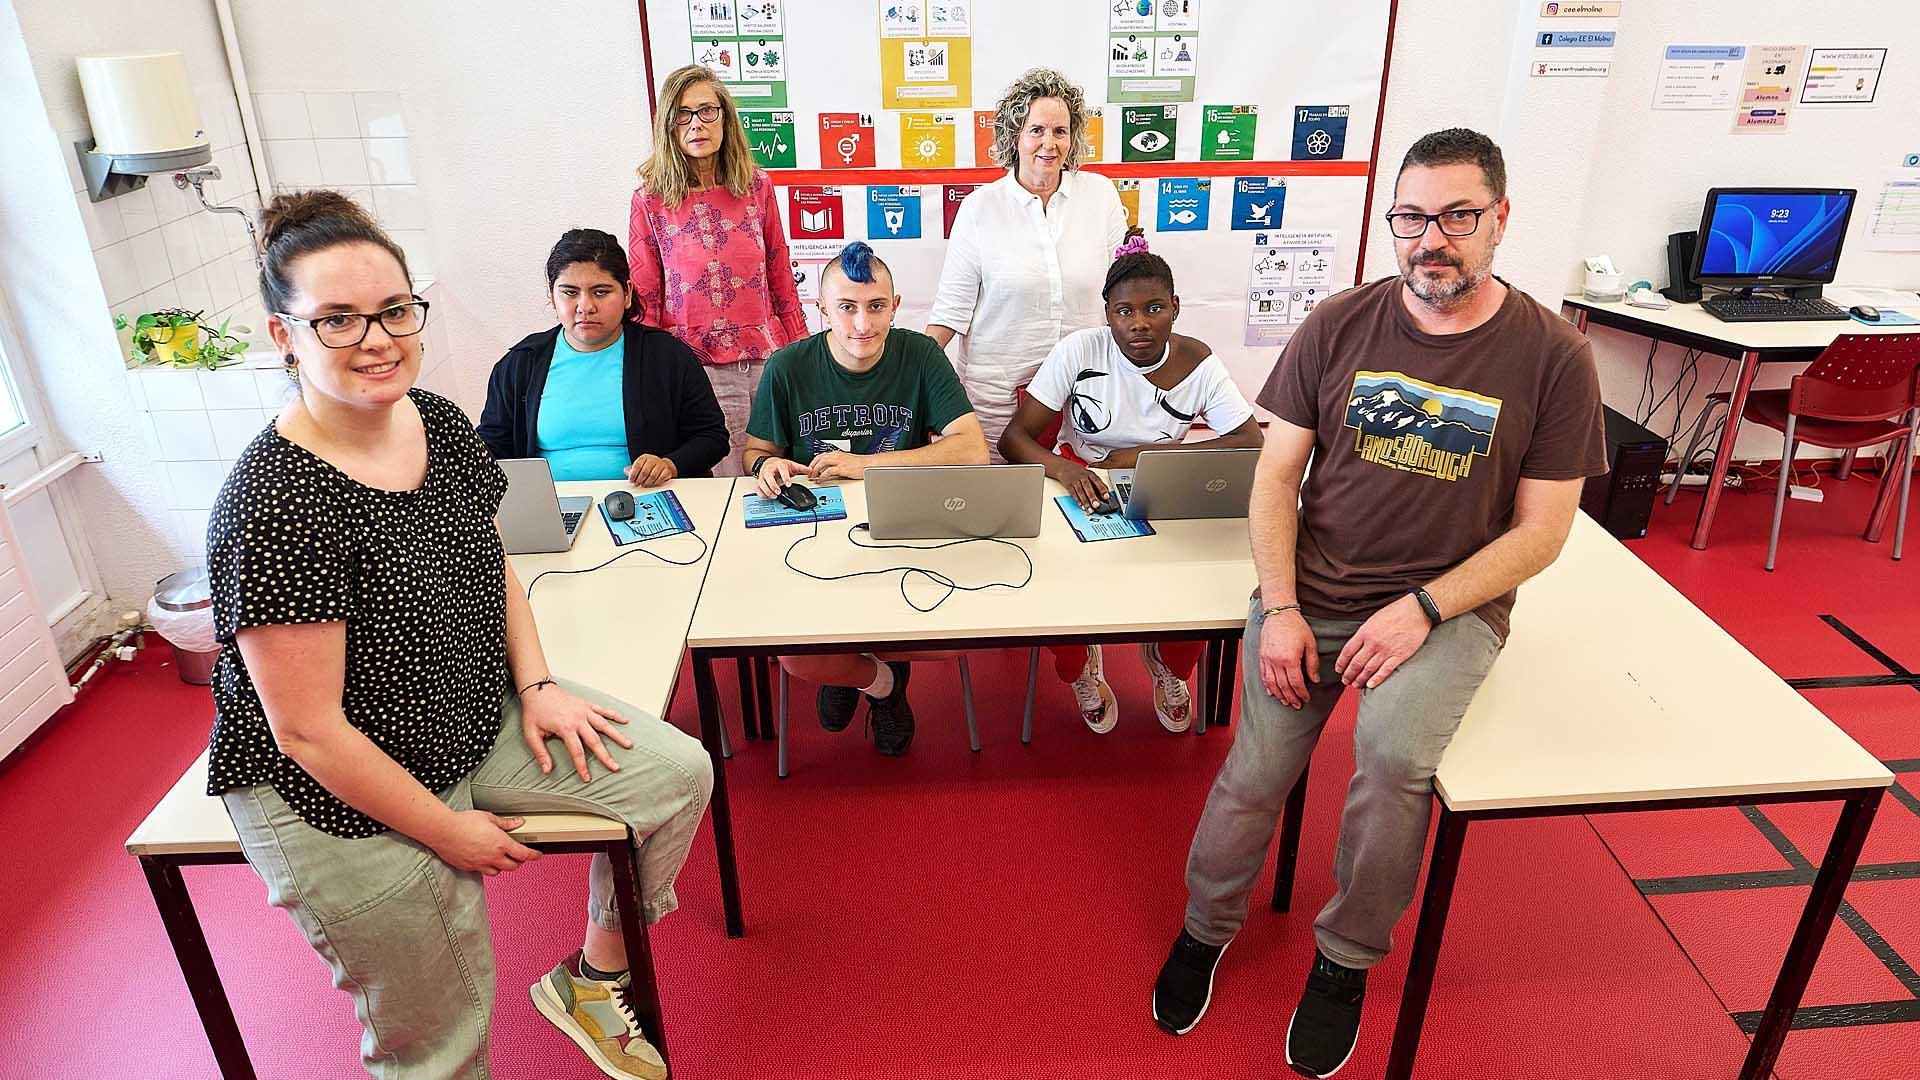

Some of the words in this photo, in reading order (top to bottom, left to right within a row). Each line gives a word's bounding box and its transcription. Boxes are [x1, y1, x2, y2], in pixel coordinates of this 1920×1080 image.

[743, 116, 750, 128] 3
[980, 116, 985, 128] 9
[1126, 110, 1136, 124] 13
[1207, 110, 1217, 122] 15
[1299, 110, 1308, 122] 17
[823, 117, 830, 129] 5
[906, 117, 912, 129] 7
[1162, 182, 1171, 194] 14
[1238, 181, 1248, 193] 16
[794, 190, 800, 201] 4
[872, 190, 877, 202] 6
[949, 189, 955, 201] 8
[1771, 209, 1789, 218] 9:23
[799, 403, 912, 437] DETROIT
[841, 428, 873, 437] Superior
[1354, 422, 1475, 482] LANDSBOROUGH
[1379, 459, 1396, 469] Valley,
[1411, 468, 1436, 476] Zealand
[944, 497, 966, 511] hp
